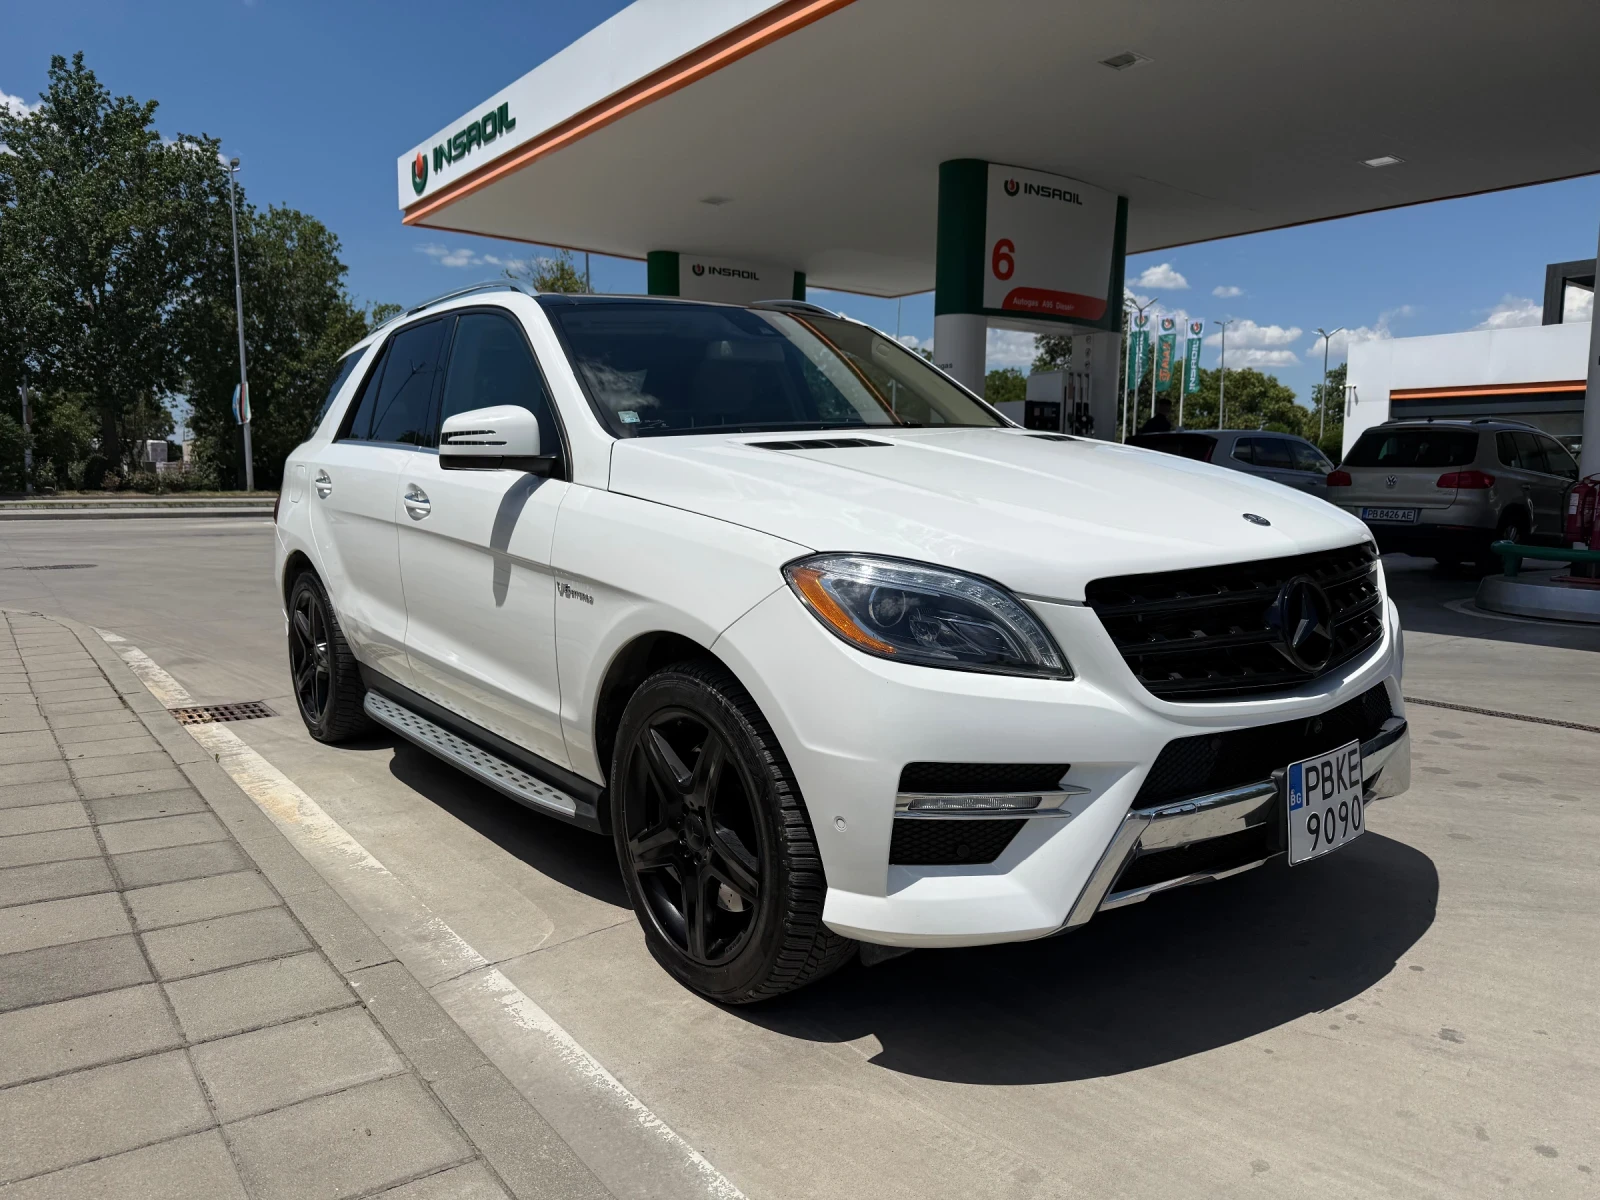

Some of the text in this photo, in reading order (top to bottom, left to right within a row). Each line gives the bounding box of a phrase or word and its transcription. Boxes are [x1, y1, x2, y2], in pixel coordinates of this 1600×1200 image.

[433, 101, 516, 174] INSAOIL
[1024, 183, 1083, 205] INSAOIL
[992, 238, 1015, 281] 6
[708, 266, 759, 281] INSAOIL
[1013, 297, 1039, 308] Autogas
[1042, 300, 1054, 309] A95
[1367, 509, 1413, 520] PB 8426 AE
[1305, 747, 1360, 806] PBKE
[1290, 792, 1302, 806] BG
[1306, 795, 1361, 852] 9090
